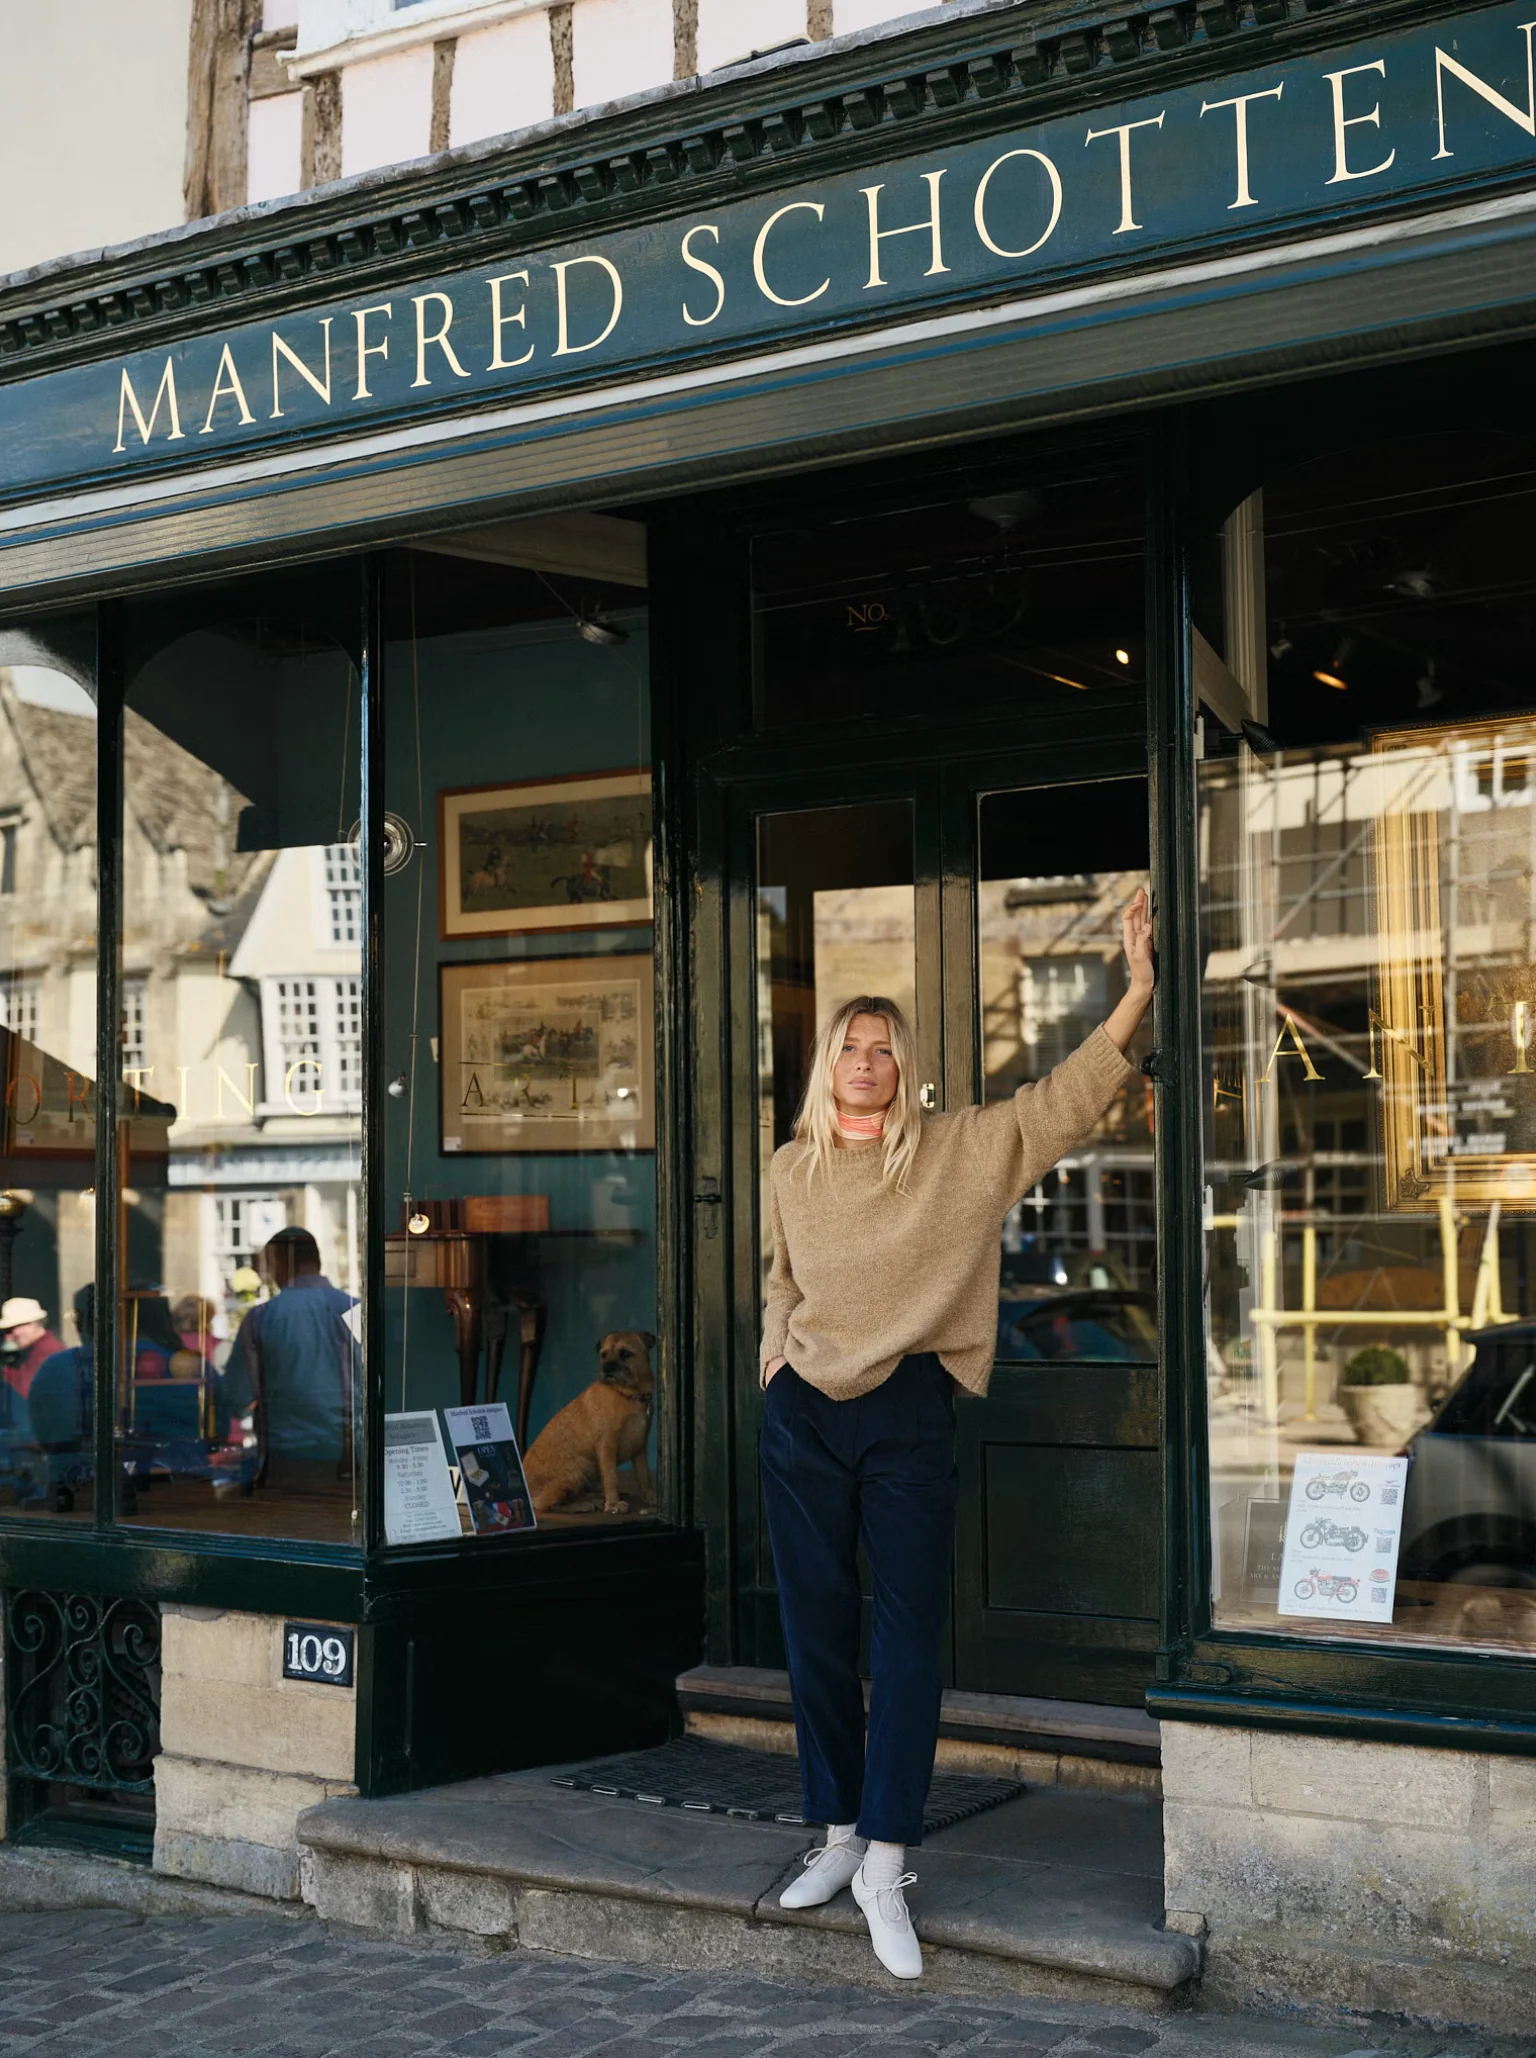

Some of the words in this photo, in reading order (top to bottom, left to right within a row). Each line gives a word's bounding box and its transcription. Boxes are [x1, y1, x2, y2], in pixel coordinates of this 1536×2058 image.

[111, 254, 625, 454] MANFRED
[680, 21, 1536, 328] SCHOTTEN
[5, 1059, 326, 1125] ORTING
[287, 1633, 346, 1676] 109
